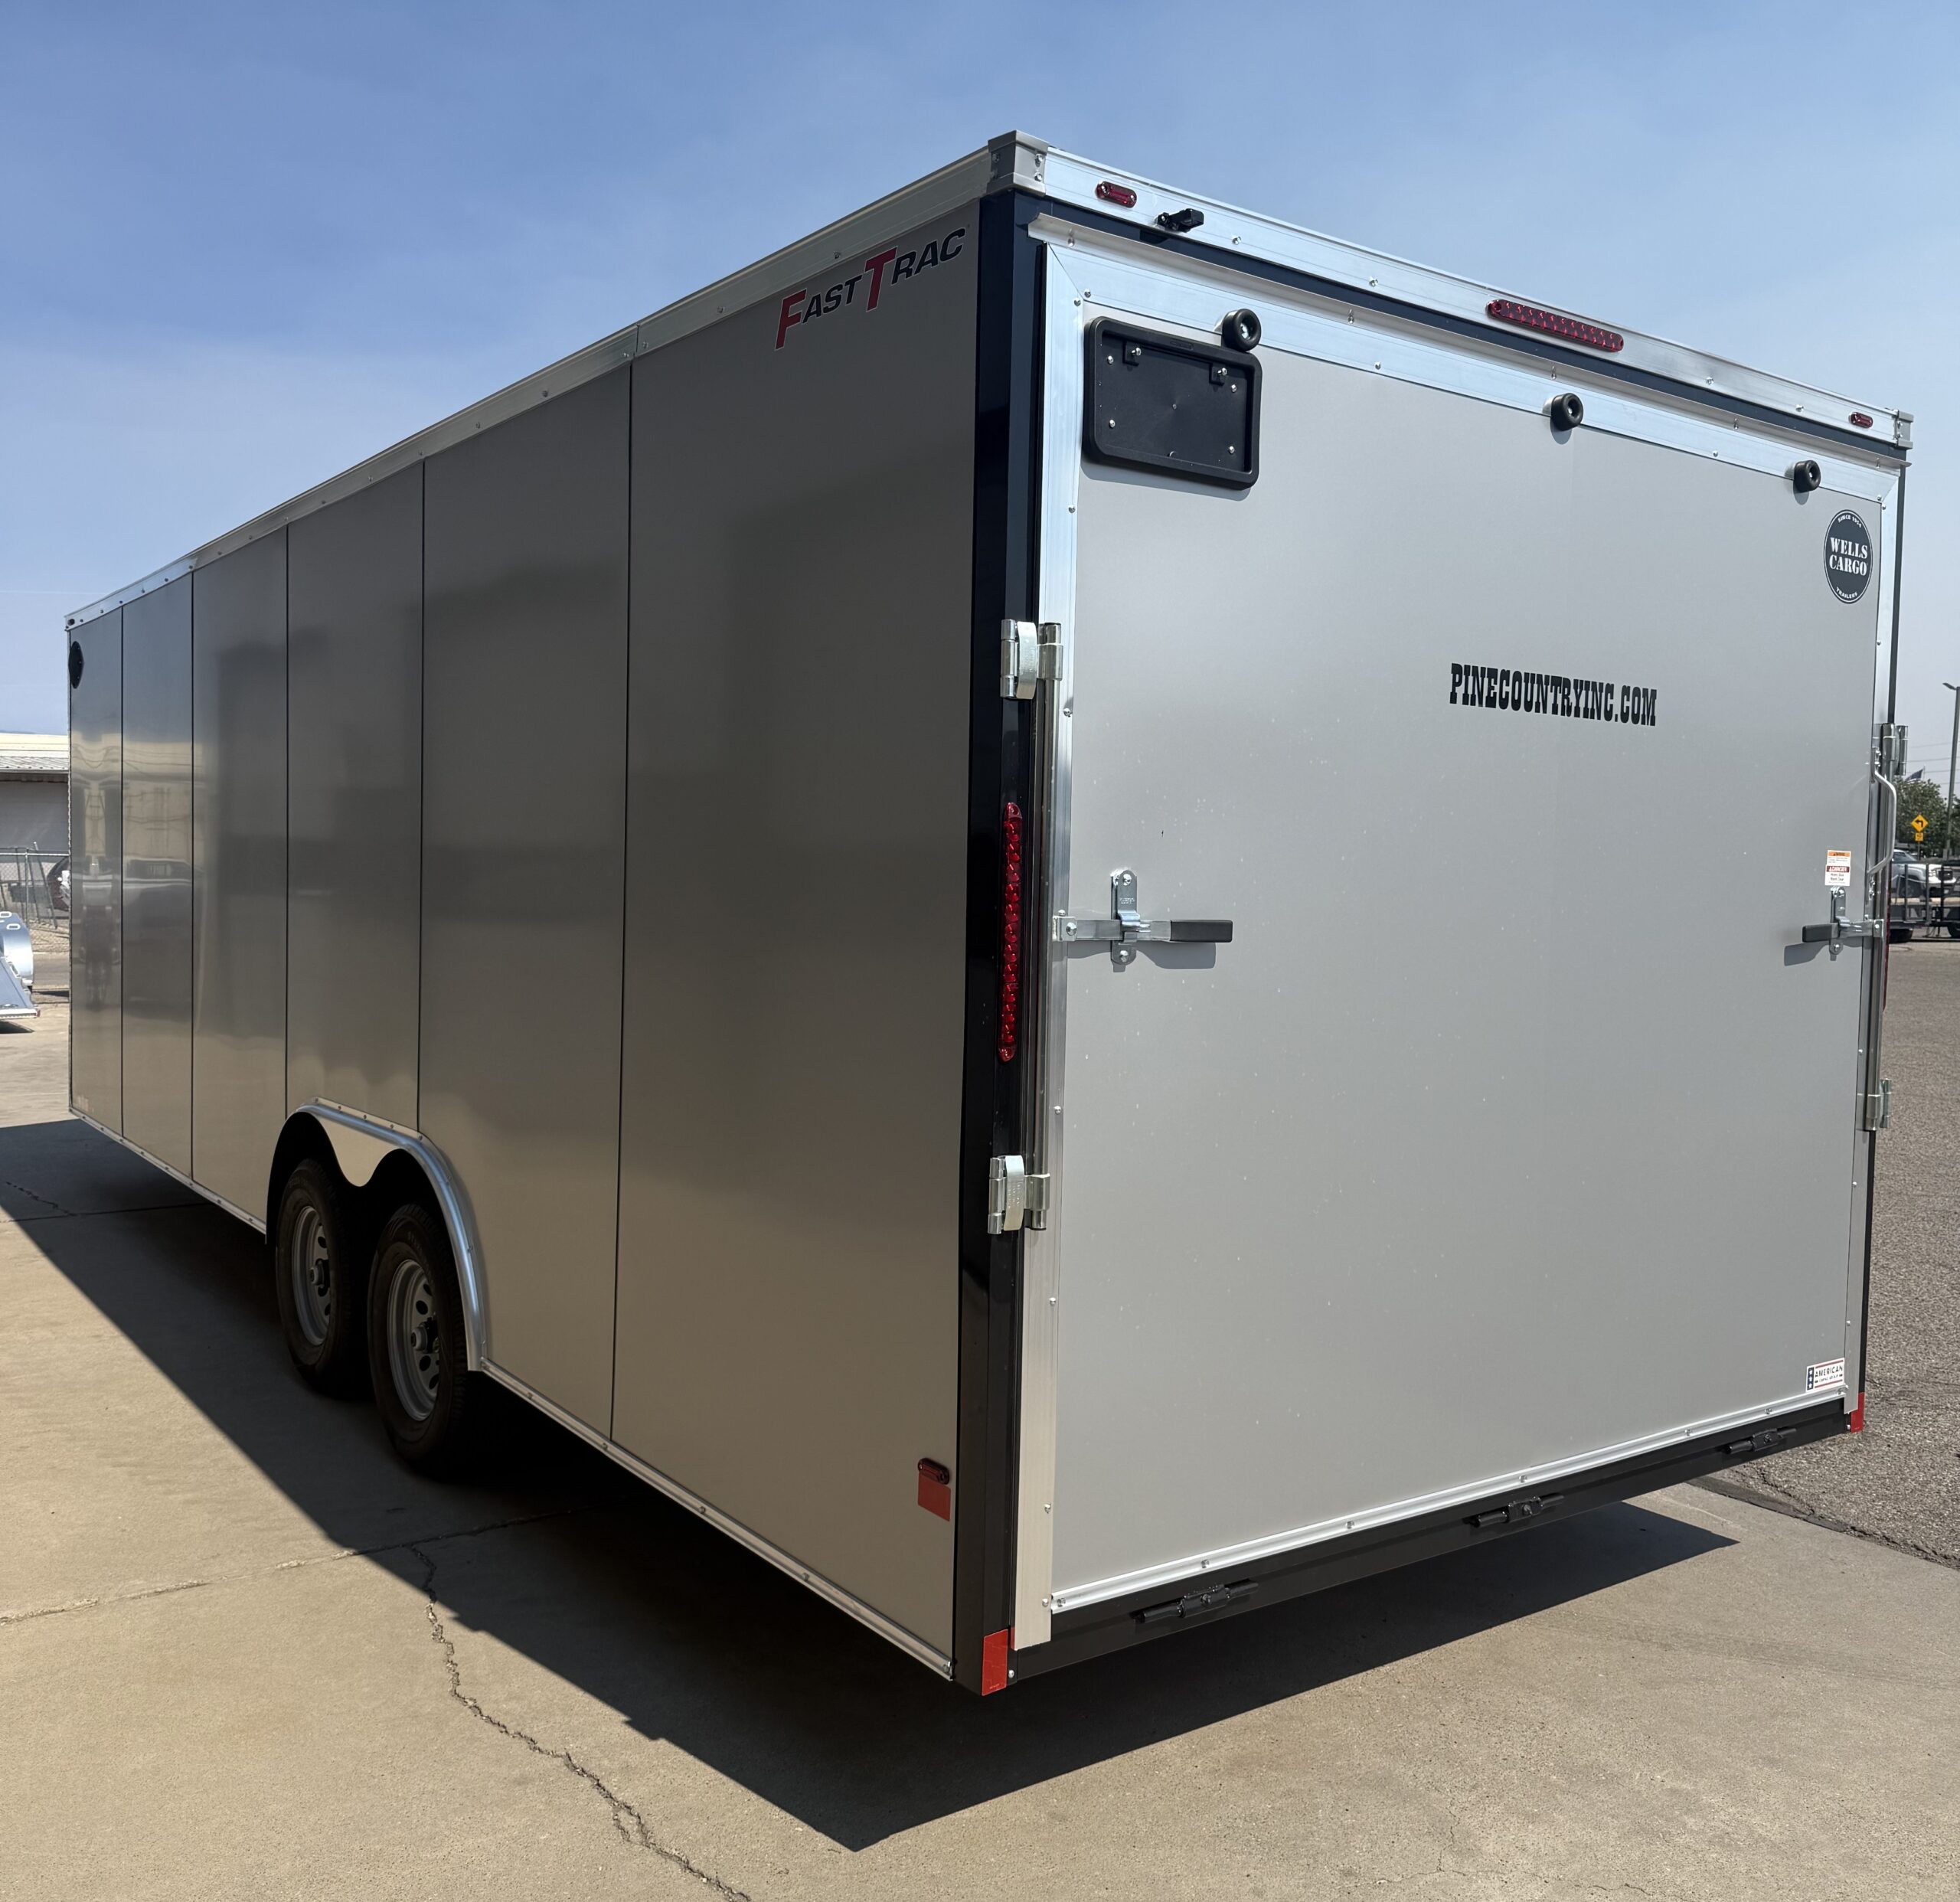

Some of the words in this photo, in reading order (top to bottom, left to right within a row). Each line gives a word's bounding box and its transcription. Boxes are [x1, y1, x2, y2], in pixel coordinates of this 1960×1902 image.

[1830, 537, 1868, 560] WELLS
[1829, 554, 1867, 577] CARGO
[1449, 662, 1658, 727] PINECOUNTRYINC.COM
[1815, 1364, 1843, 1378] AMERICAN
